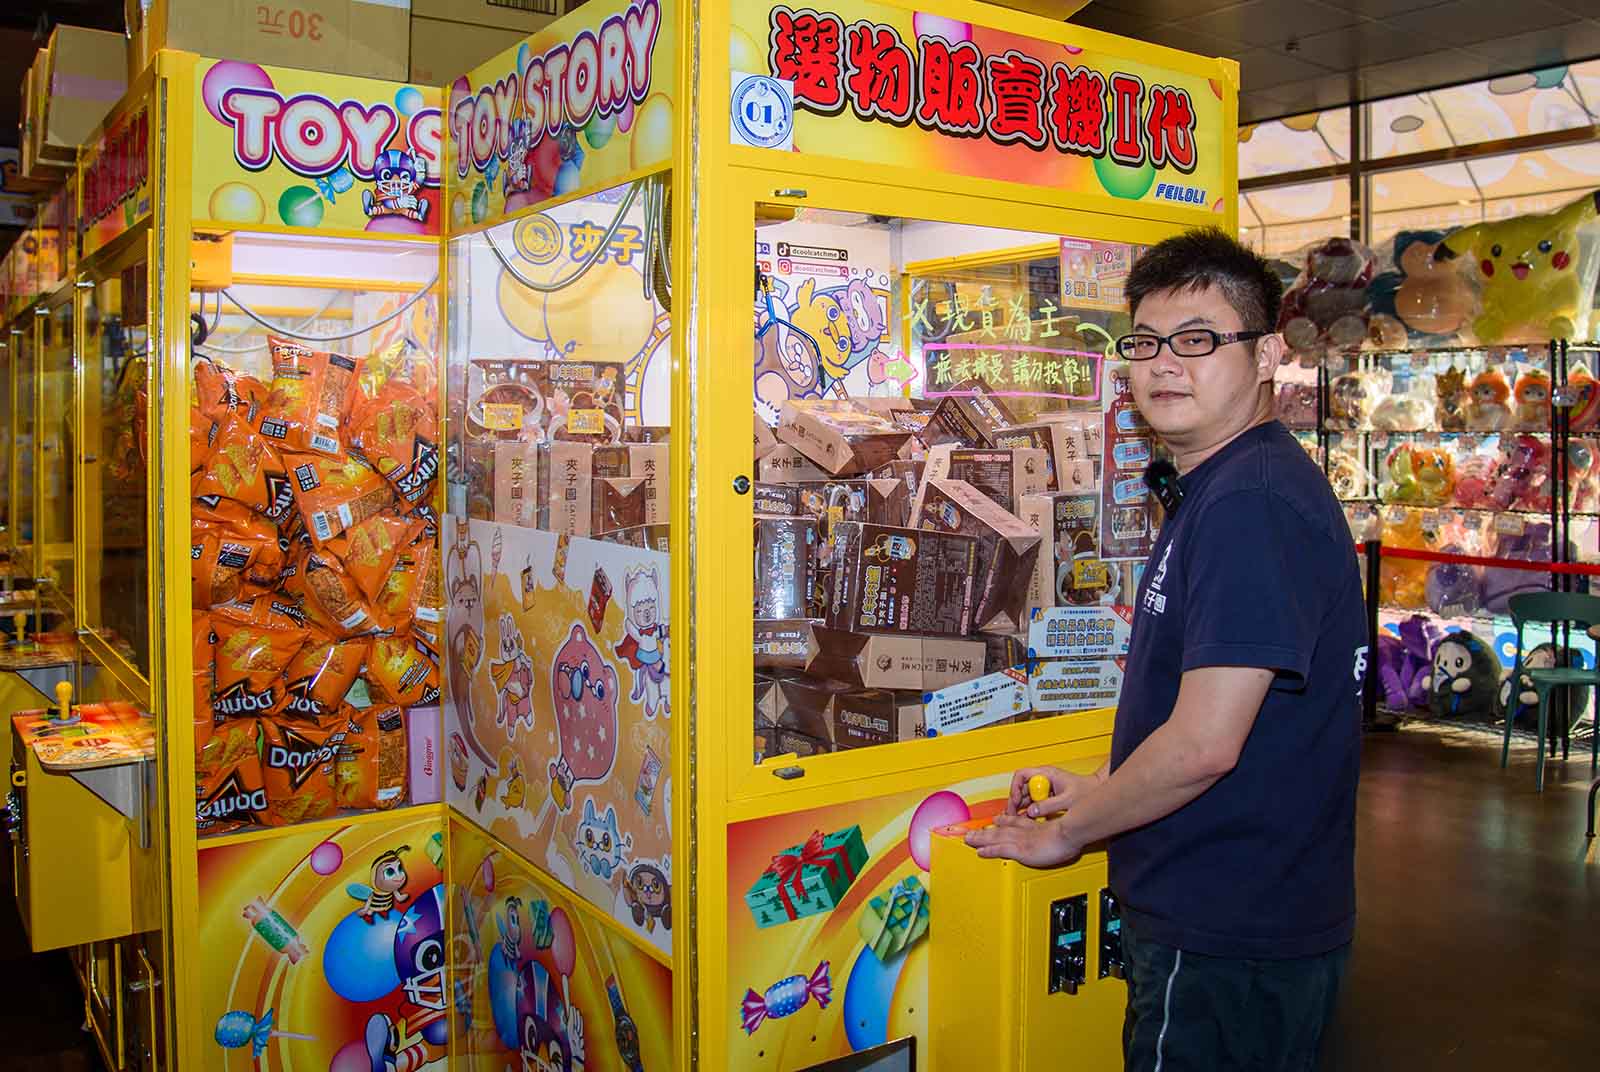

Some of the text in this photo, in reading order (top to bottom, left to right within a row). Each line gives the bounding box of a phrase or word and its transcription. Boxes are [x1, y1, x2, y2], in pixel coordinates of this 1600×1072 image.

[257, 5, 324, 41] 30元
[452, 0, 662, 180] TOY STORY
[219, 87, 400, 181] TOY
[1155, 182, 1207, 205] FEILOLI
[792, 247, 838, 259] dcoolcatchme
